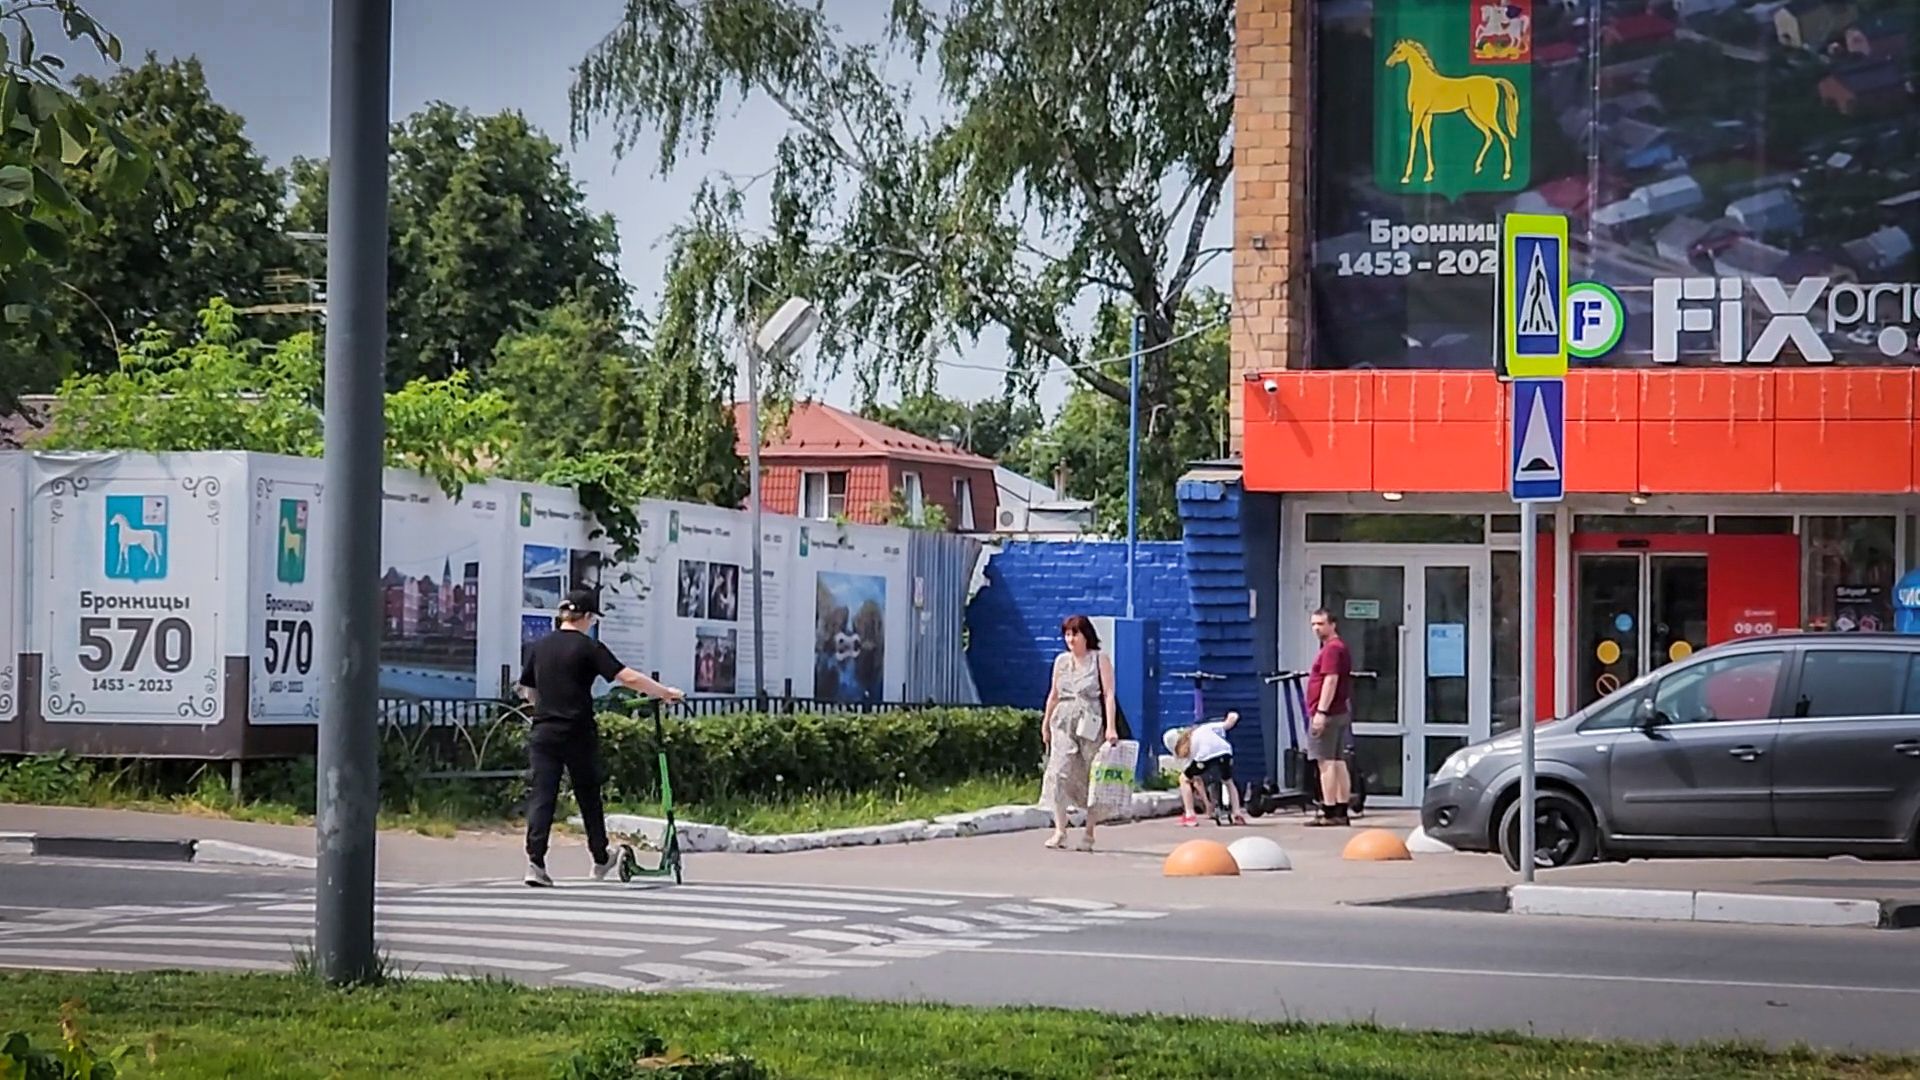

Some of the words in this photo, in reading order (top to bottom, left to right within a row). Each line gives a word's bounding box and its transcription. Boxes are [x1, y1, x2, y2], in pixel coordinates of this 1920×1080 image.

[1370, 219, 1499, 249] Бронниц
[1337, 251, 1412, 276] 1453
[1437, 250, 1498, 275] 202
[1828, 282, 1920, 334] pri
[80, 591, 190, 613] Бронницы
[78, 617, 192, 673] 570
[264, 620, 314, 675] 570
[92, 678, 124, 691] 1453
[138, 678, 173, 692] 2023
